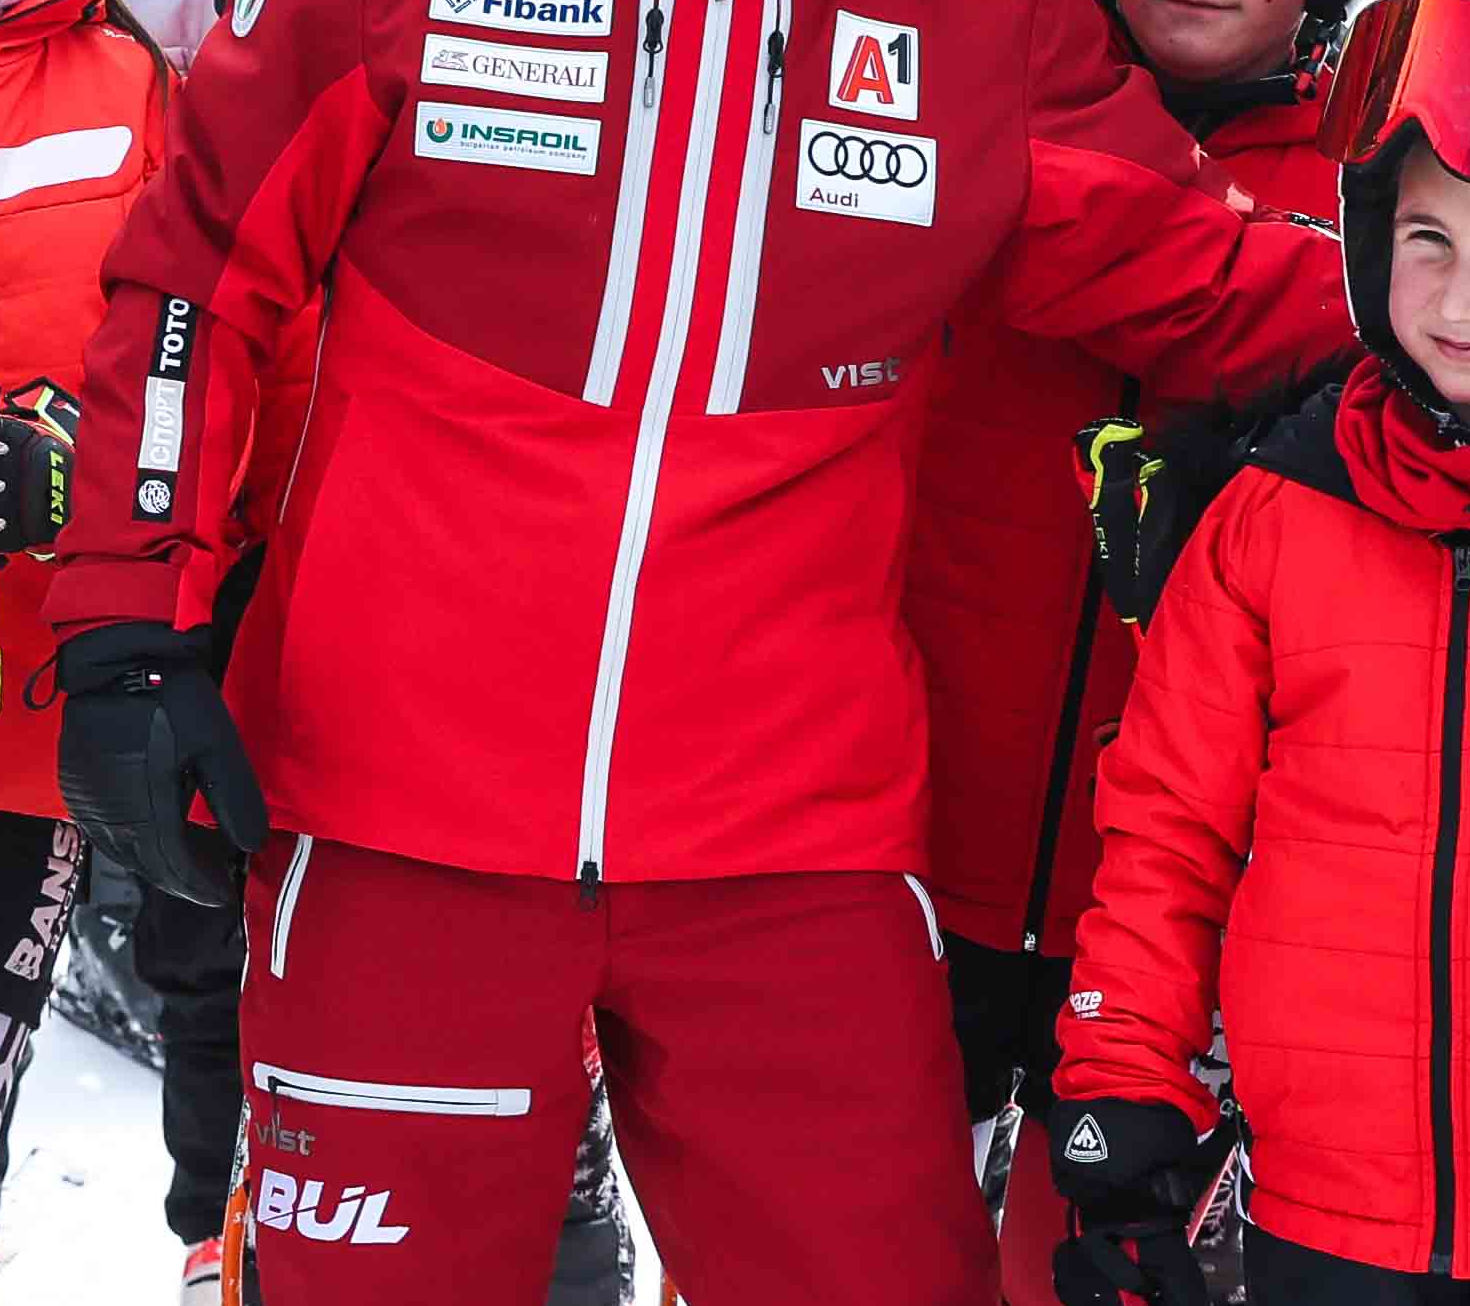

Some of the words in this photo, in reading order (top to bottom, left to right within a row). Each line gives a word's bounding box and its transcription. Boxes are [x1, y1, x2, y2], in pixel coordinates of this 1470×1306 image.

[472, 54, 597, 88] GENERALI
[836, 33, 910, 105] A1
[461, 122, 588, 152] INSAOIL
[809, 187, 860, 208] Audi
[49, 450, 65, 525] LEKI
[3, 823, 76, 982] BANS
[257, 1168, 410, 1244] BUL
